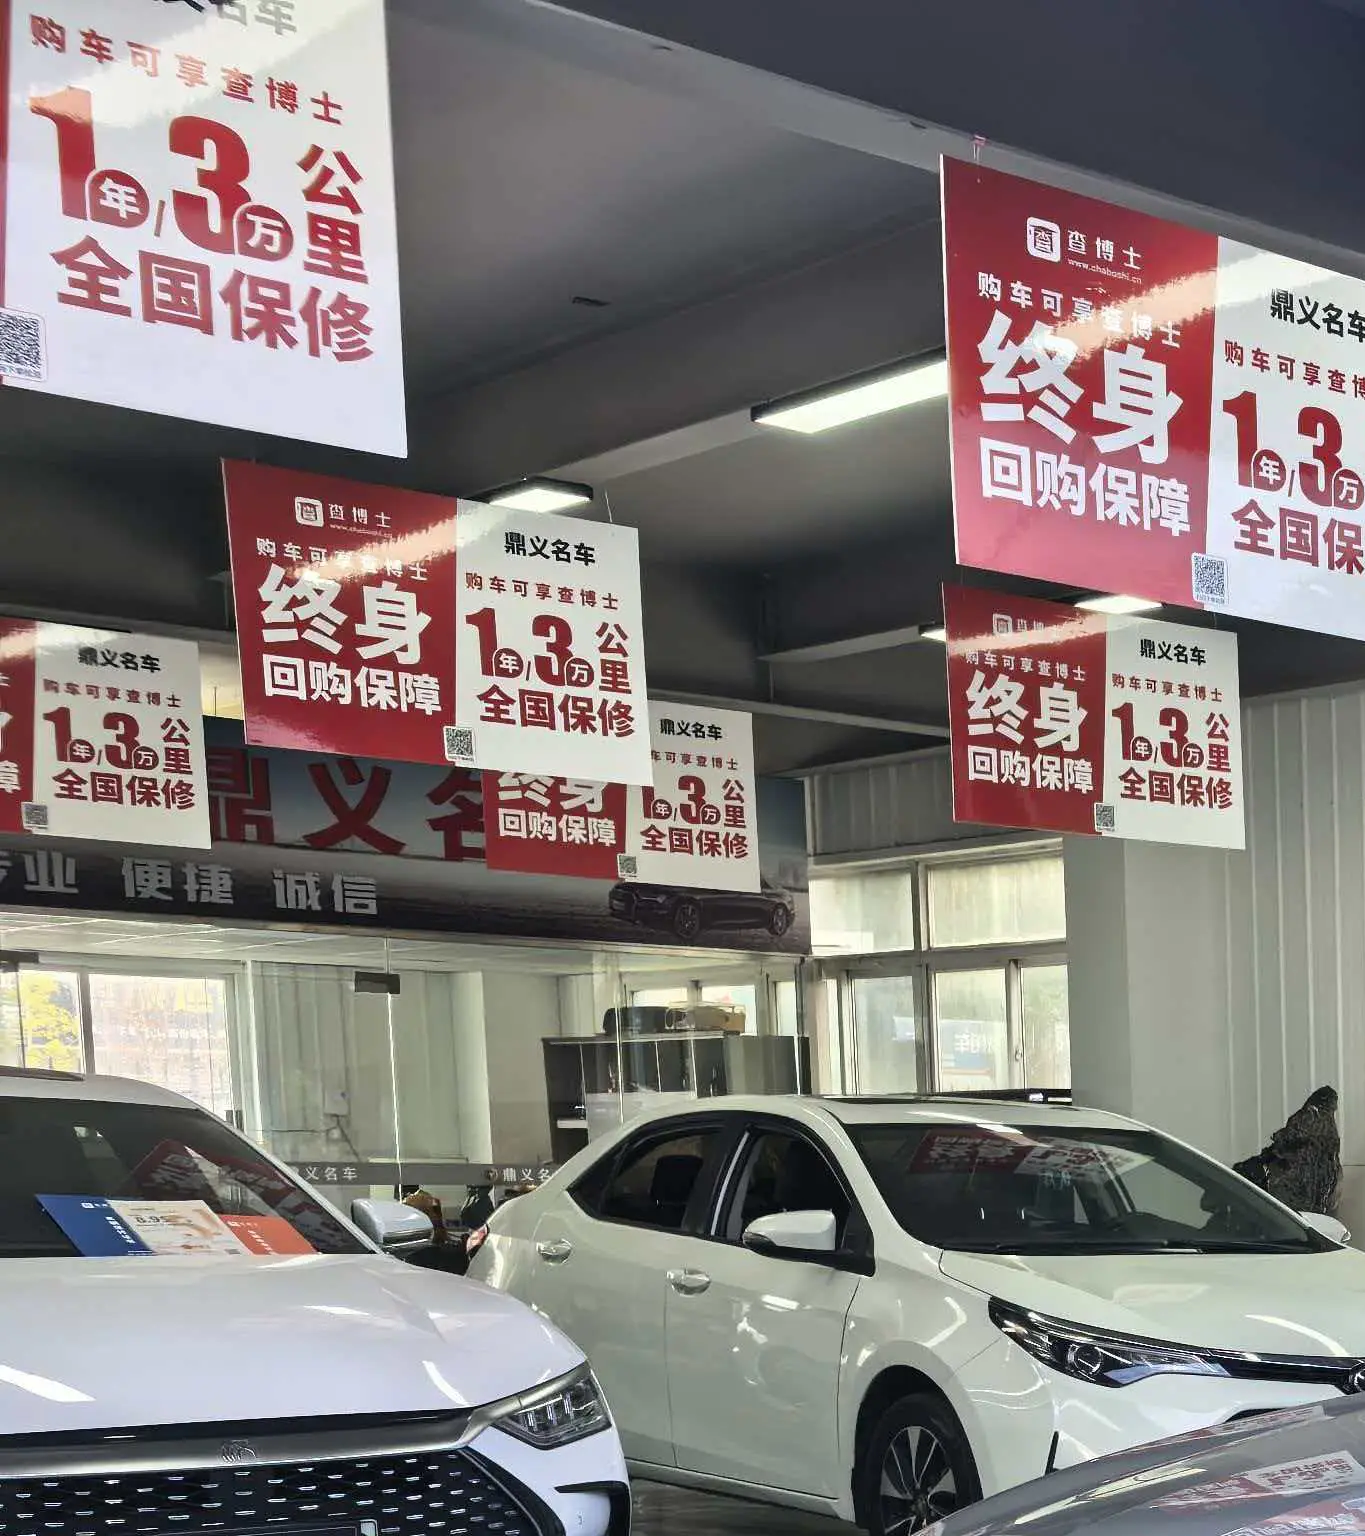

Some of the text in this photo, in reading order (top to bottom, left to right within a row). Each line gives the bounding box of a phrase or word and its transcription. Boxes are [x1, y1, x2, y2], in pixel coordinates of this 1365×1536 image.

[29, 13, 343, 125] 购车可享查博士
[1067, 230, 1142, 270] 查博士
[50, 235, 375, 363] 全国保修
[976, 308, 1183, 465] 终身
[980, 436, 1191, 537] 回购保障
[504, 531, 596, 566] 鼎义名车
[465, 572, 619, 611] 购车可享查博士
[257, 562, 432, 666] 终身
[78, 646, 162, 673] 鼎义名车
[1139, 638, 1207, 666] 鼎义名车
[262, 653, 442, 717] 回购保障
[1112, 672, 1223, 703] 购车可享查博士
[476, 684, 635, 738] 全国保修
[660, 718, 723, 741] 鼎义名车
[965, 669, 1088, 752] 终身
[52, 768, 196, 811] 全国保修
[967, 744, 1094, 794] 回购保障
[1118, 766, 1234, 810] 全国保修
[498, 807, 617, 847] 回购保障
[640, 823, 748, 859] 全国保修
[0, 848, 379, 916] 业 便捷 诚信
[293, 1165, 358, 1181] 义名车
